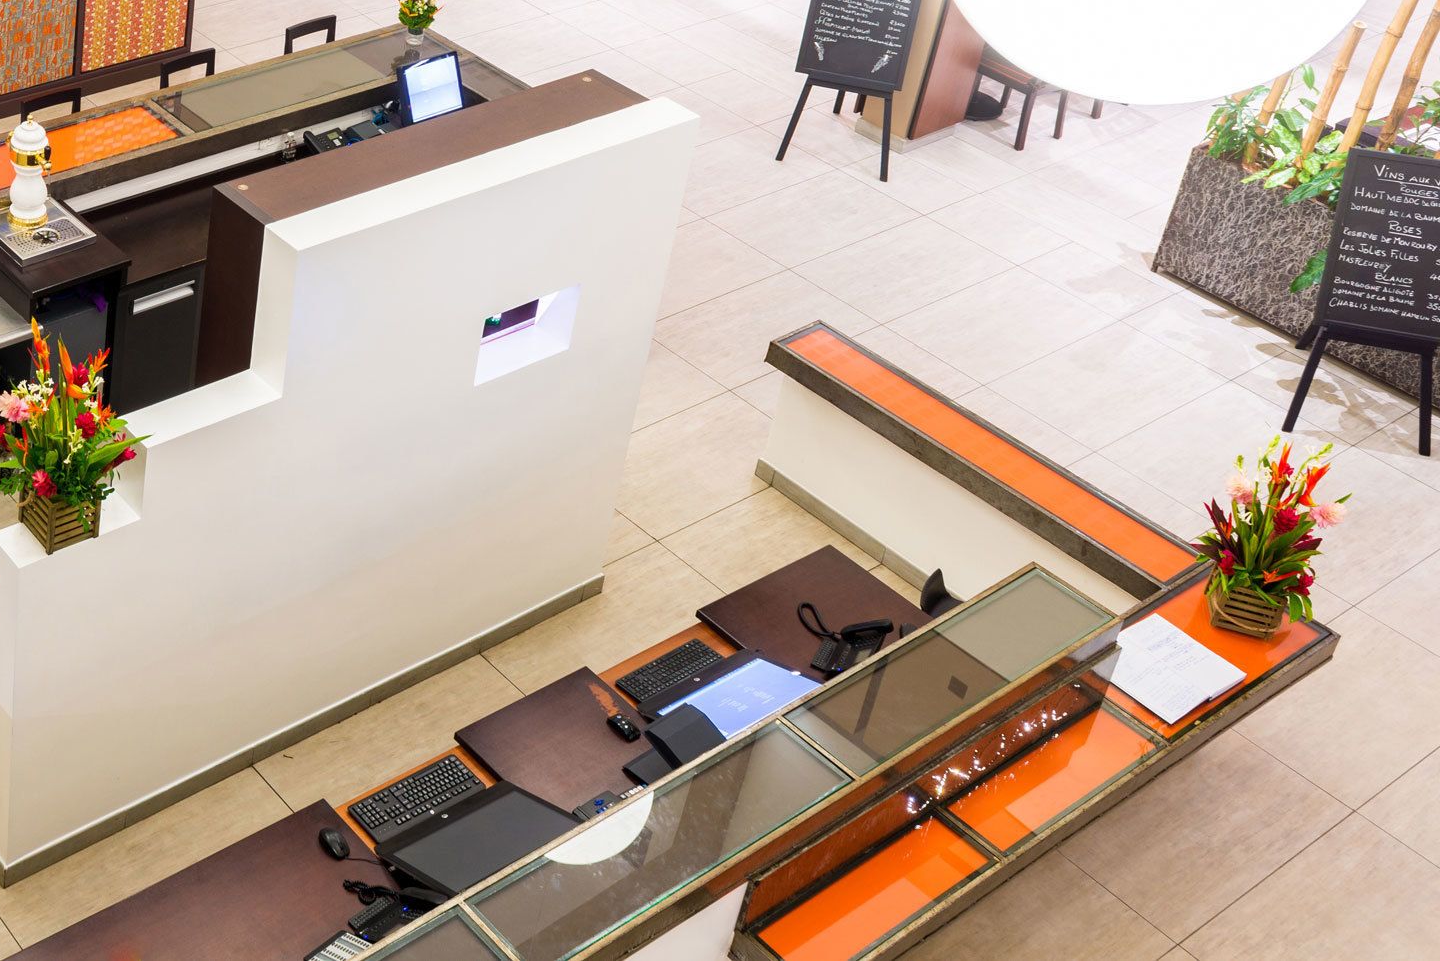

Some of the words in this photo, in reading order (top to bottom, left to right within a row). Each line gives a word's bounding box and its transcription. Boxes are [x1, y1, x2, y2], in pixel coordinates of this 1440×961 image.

[1350, 202, 1385, 215] DOMAINE
[1388, 220, 1423, 236] ROSES
[1333, 275, 1382, 292] BOURGOGNE
[1374, 272, 1414, 285] BLANCS
[1332, 288, 1366, 298] DOMAINE
[1328, 297, 1368, 311] CHABLIS
